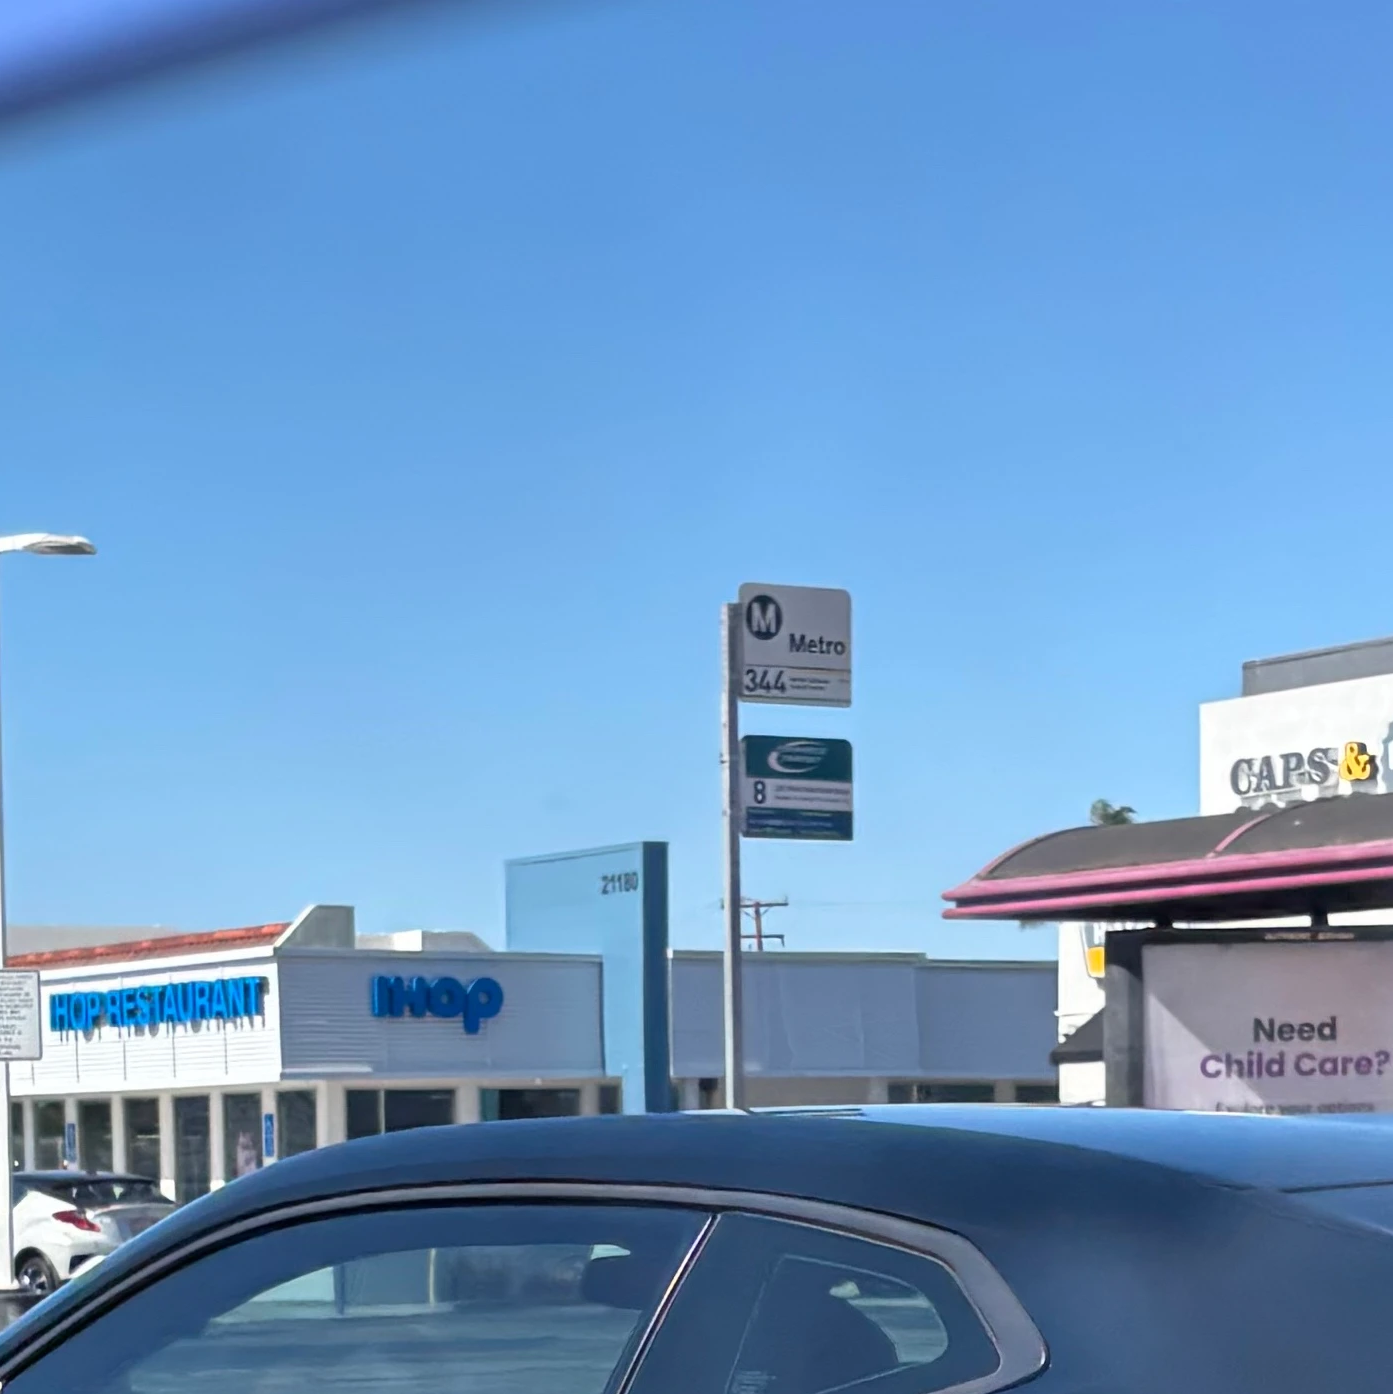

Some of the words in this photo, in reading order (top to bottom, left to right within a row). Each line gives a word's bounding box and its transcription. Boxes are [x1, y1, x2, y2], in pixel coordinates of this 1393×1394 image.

[789, 633, 846, 655] Metro
[745, 669, 787, 692] 344
[1230, 748, 1335, 796] CAPS
[1339, 742, 1372, 781] &
[753, 780, 766, 804] 8
[106, 977, 266, 1028] RESTAURANT
[371, 976, 504, 1034] IHOP
[1253, 1016, 1337, 1043] Need
[1200, 1050, 1286, 1079] Child
[1294, 1050, 1390, 1077] Care?
